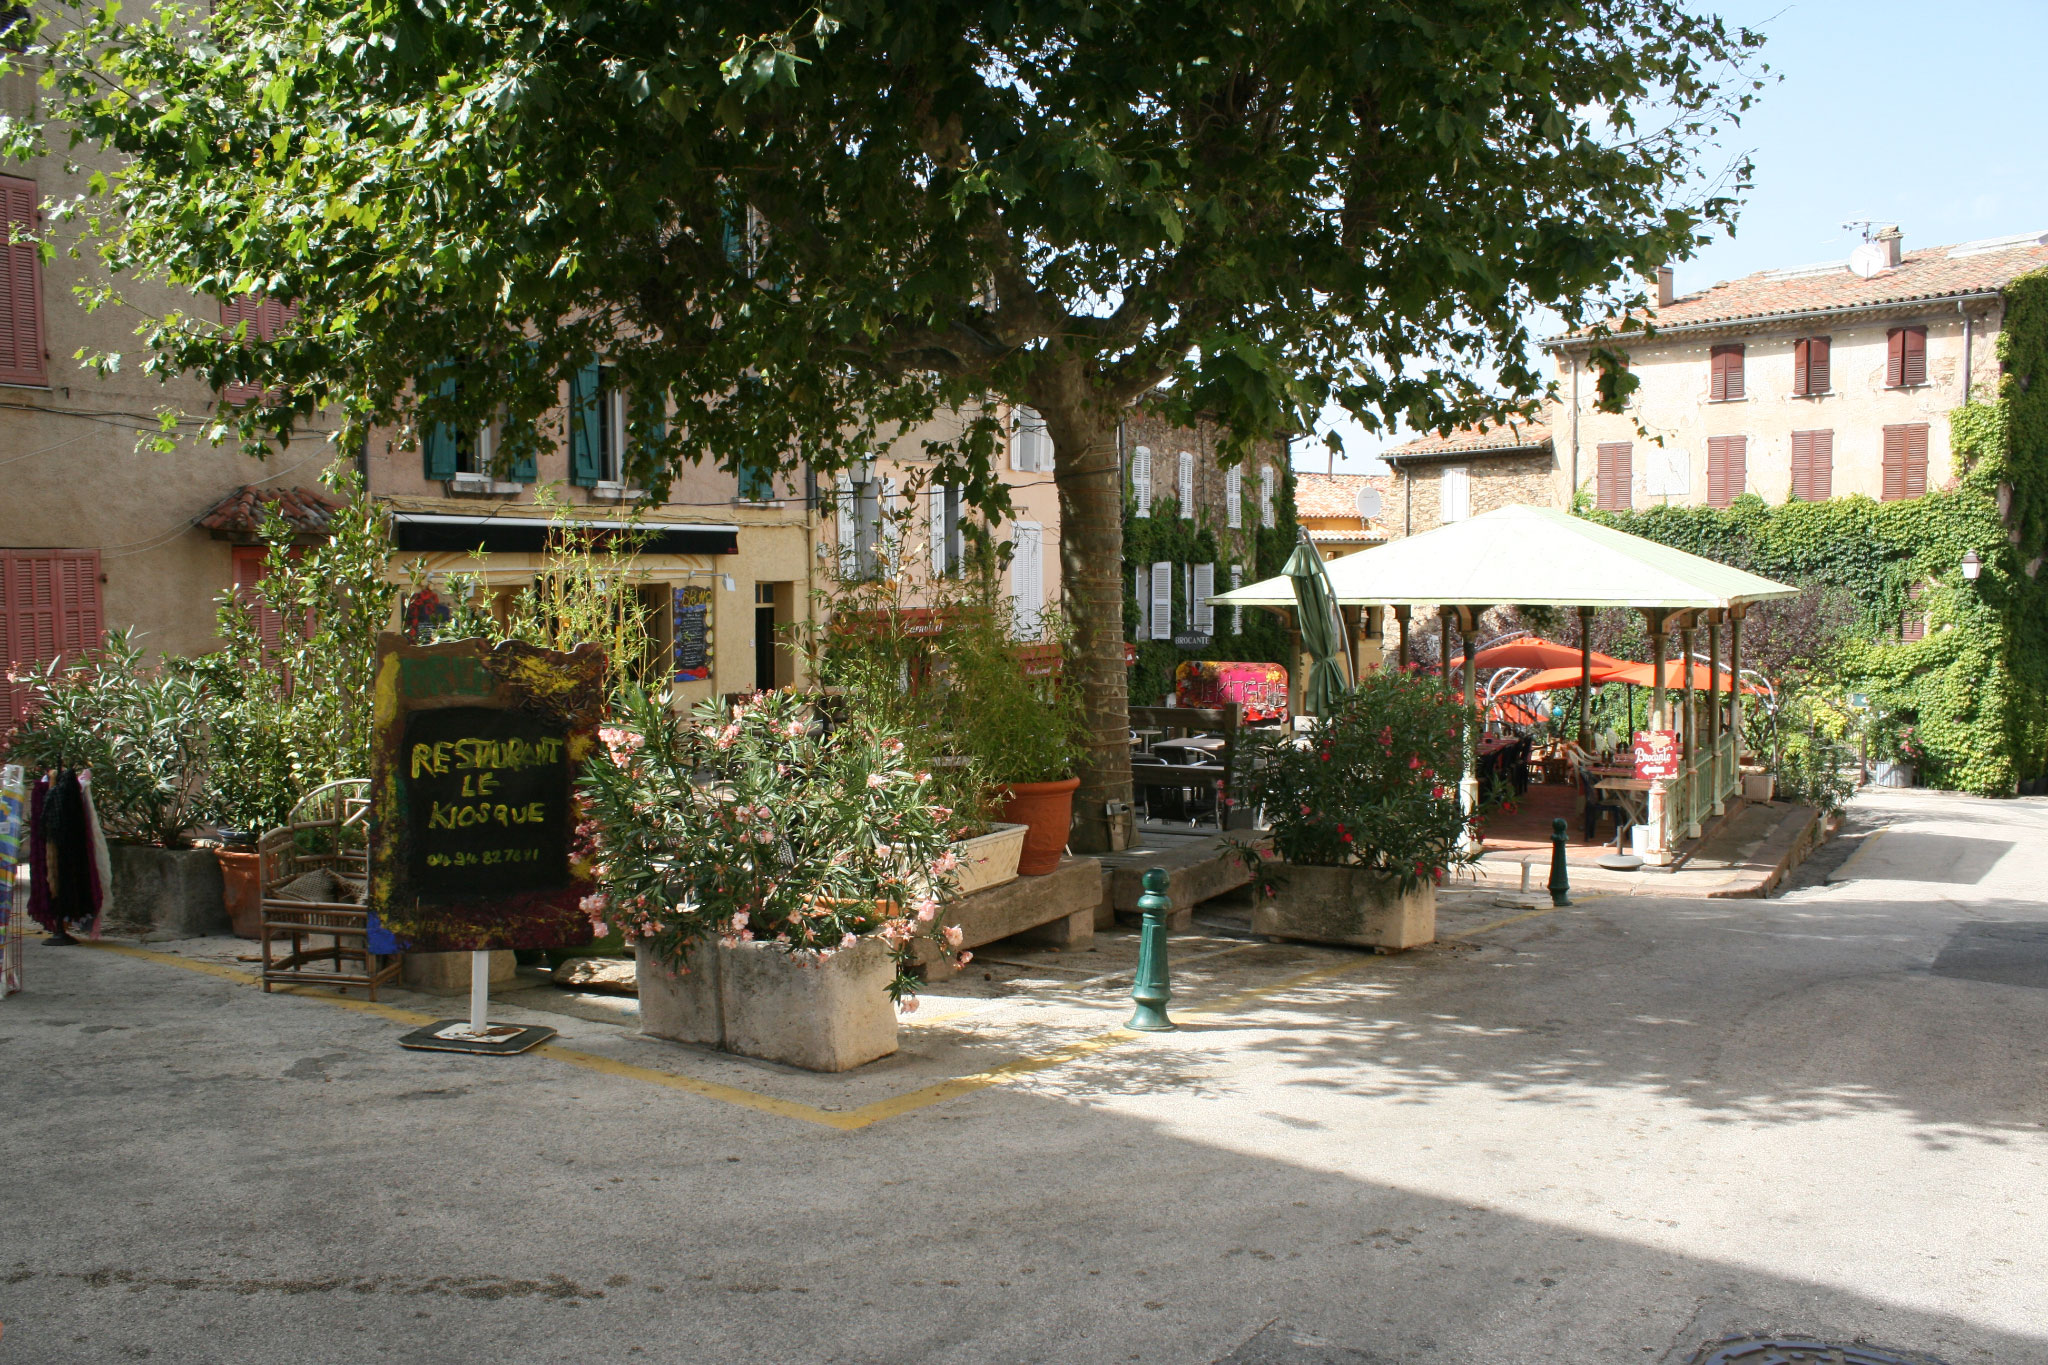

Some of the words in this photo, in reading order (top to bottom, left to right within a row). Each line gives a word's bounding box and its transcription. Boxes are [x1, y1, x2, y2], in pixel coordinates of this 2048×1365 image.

[1174, 636, 1211, 645] BROCANTE
[1634, 745, 1673, 764] Brocante
[461, 772, 500, 797] LE
[428, 801, 545, 830] KIOSQUE
